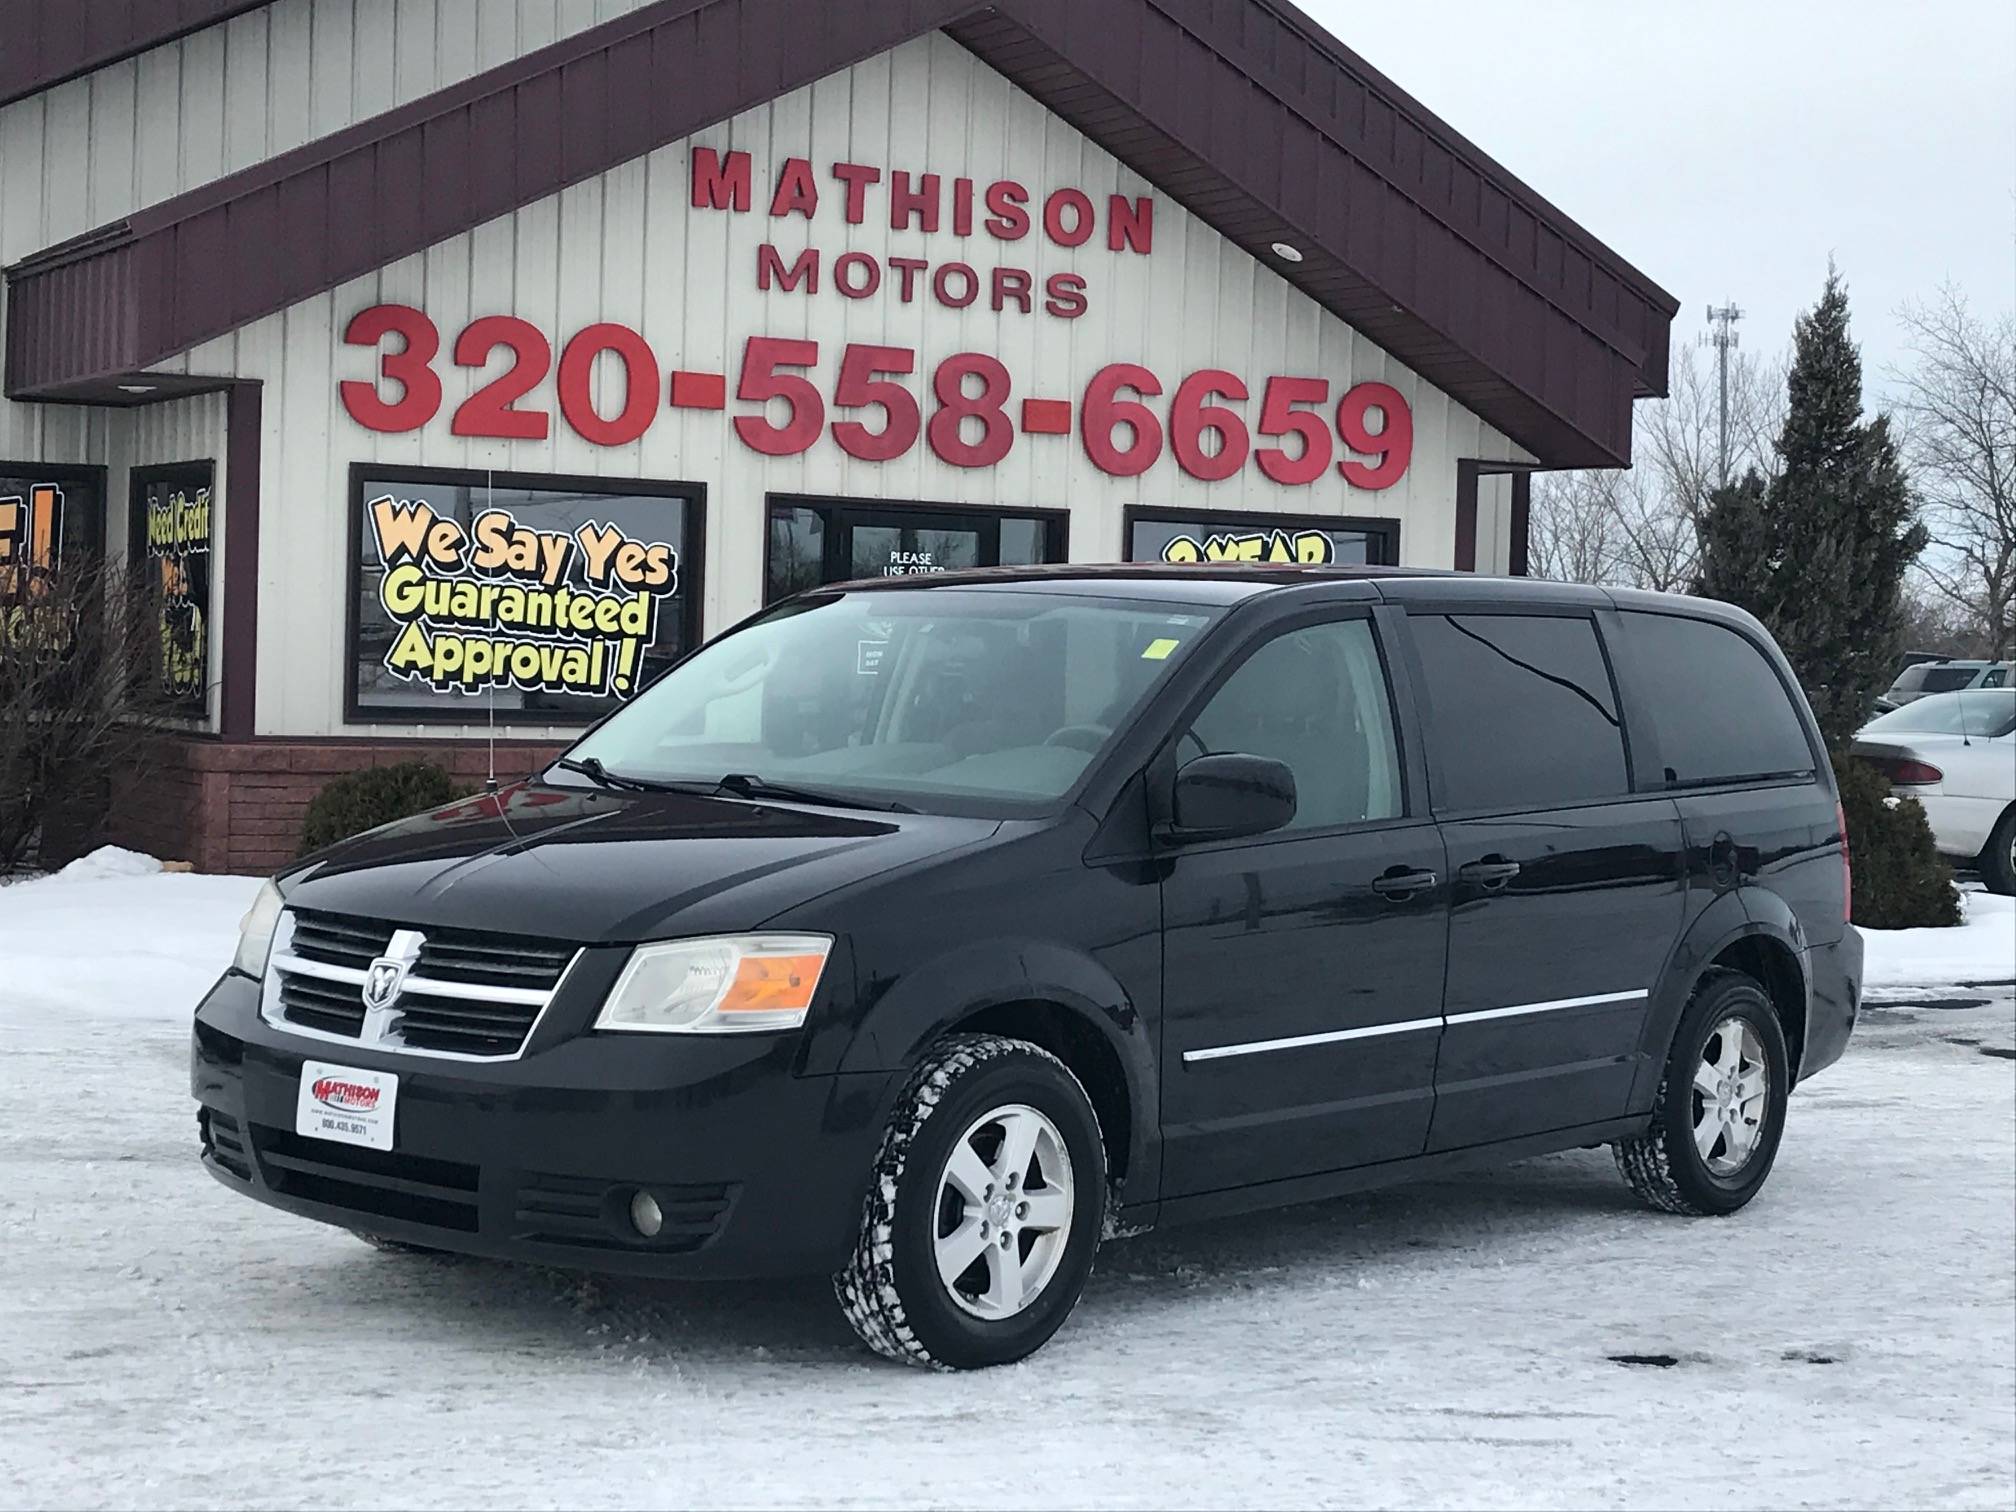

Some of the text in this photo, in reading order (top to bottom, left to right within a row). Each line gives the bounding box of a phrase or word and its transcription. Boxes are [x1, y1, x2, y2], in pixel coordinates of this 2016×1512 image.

[691, 146, 1153, 254] MATHISON
[757, 244, 1088, 319] MOTORS
[340, 303, 1414, 490] 320-558-6659
[371, 498, 673, 588] We Say Yes
[890, 551, 932, 565] PLEASE
[383, 565, 651, 636] Guaranteed
[387, 619, 638, 692] Approval!
[314, 1078, 381, 1102] MATHISON
